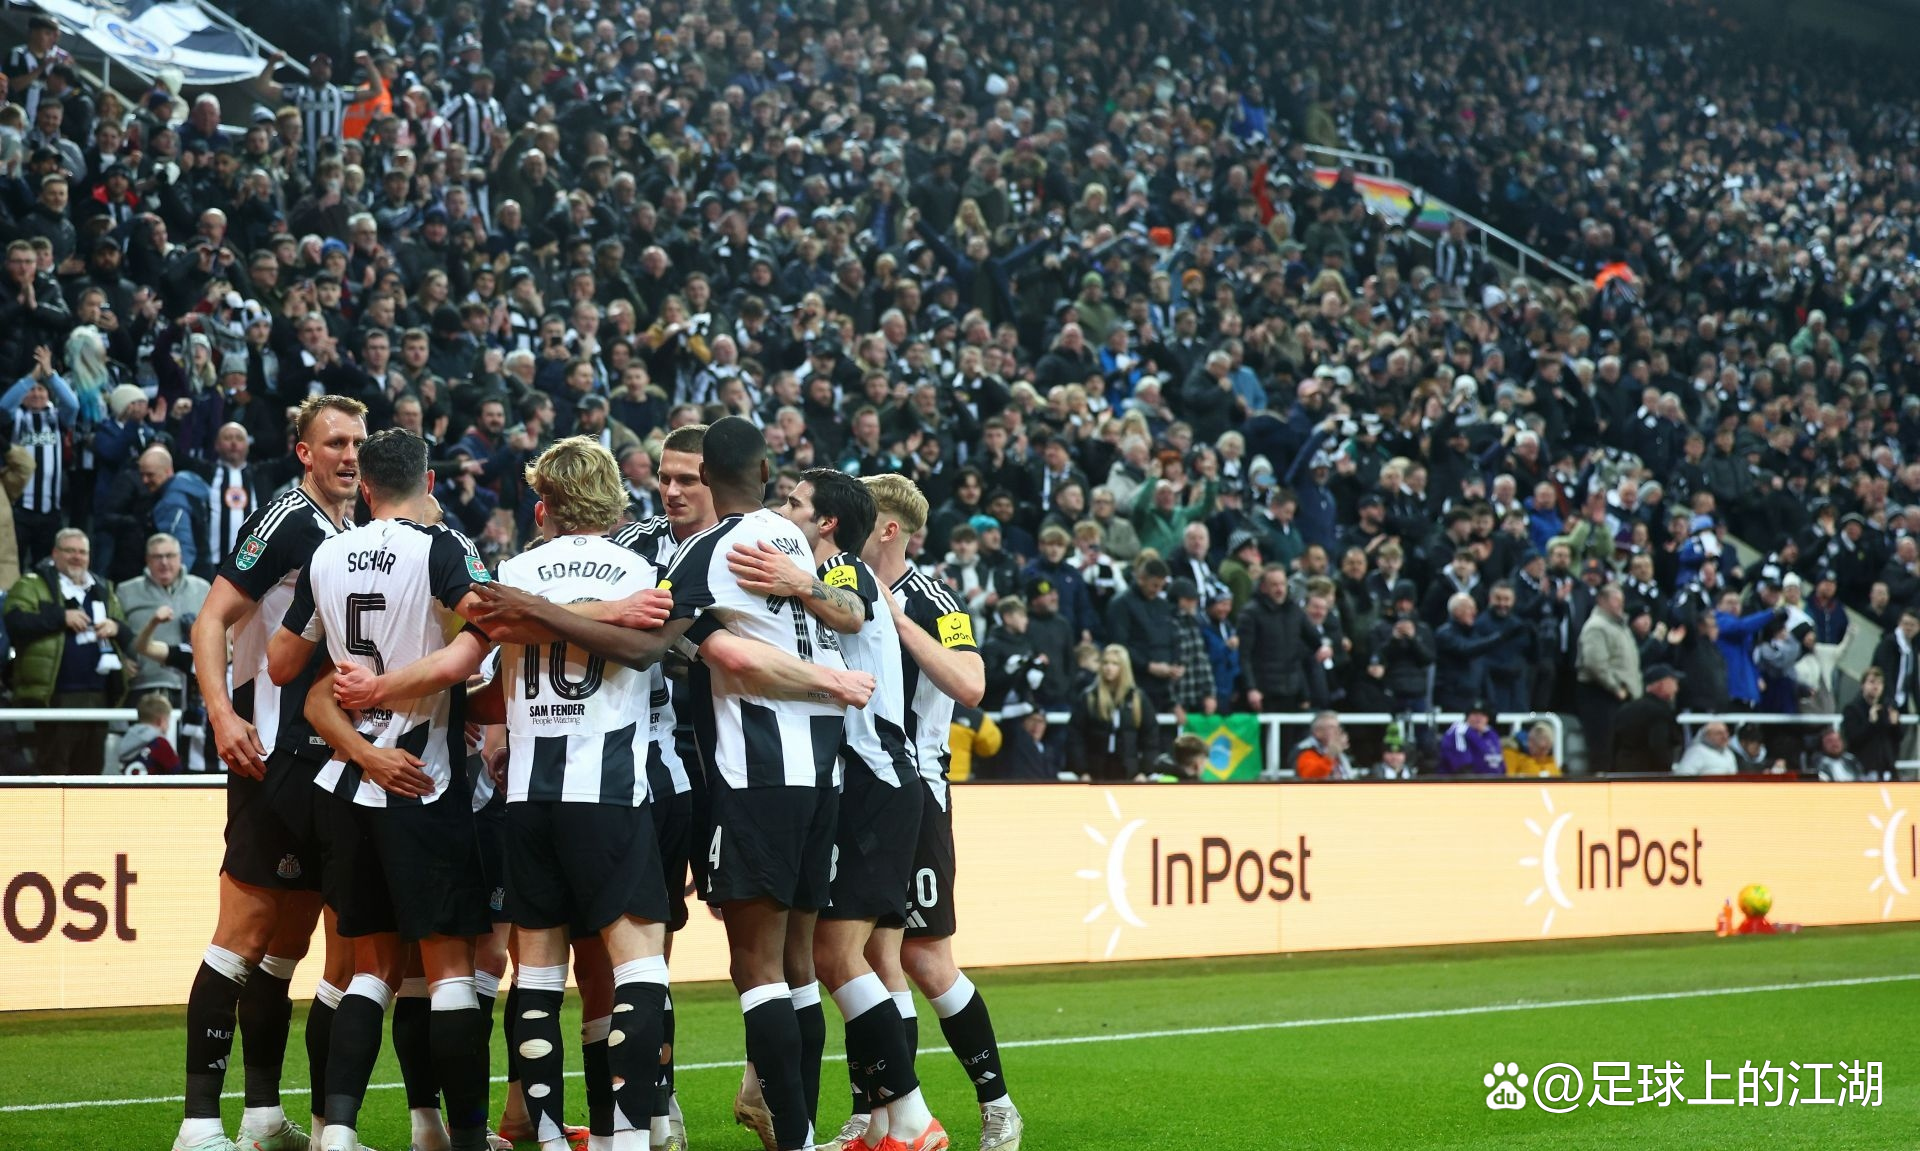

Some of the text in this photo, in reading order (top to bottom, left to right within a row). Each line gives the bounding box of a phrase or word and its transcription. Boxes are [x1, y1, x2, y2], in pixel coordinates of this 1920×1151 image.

[771, 537, 805, 557] ISAK
[537, 560, 627, 585] GORDON
[831, 576, 855, 586] oon
[345, 592, 386, 677] 5
[944, 632, 973, 643] noon
[529, 703, 586, 717] SAM FENDER
[1577, 828, 1703, 890] InPost
[1151, 835, 1311, 906] InPost
[3, 853, 138, 944] ost
[206, 1028, 233, 1040] NUF
